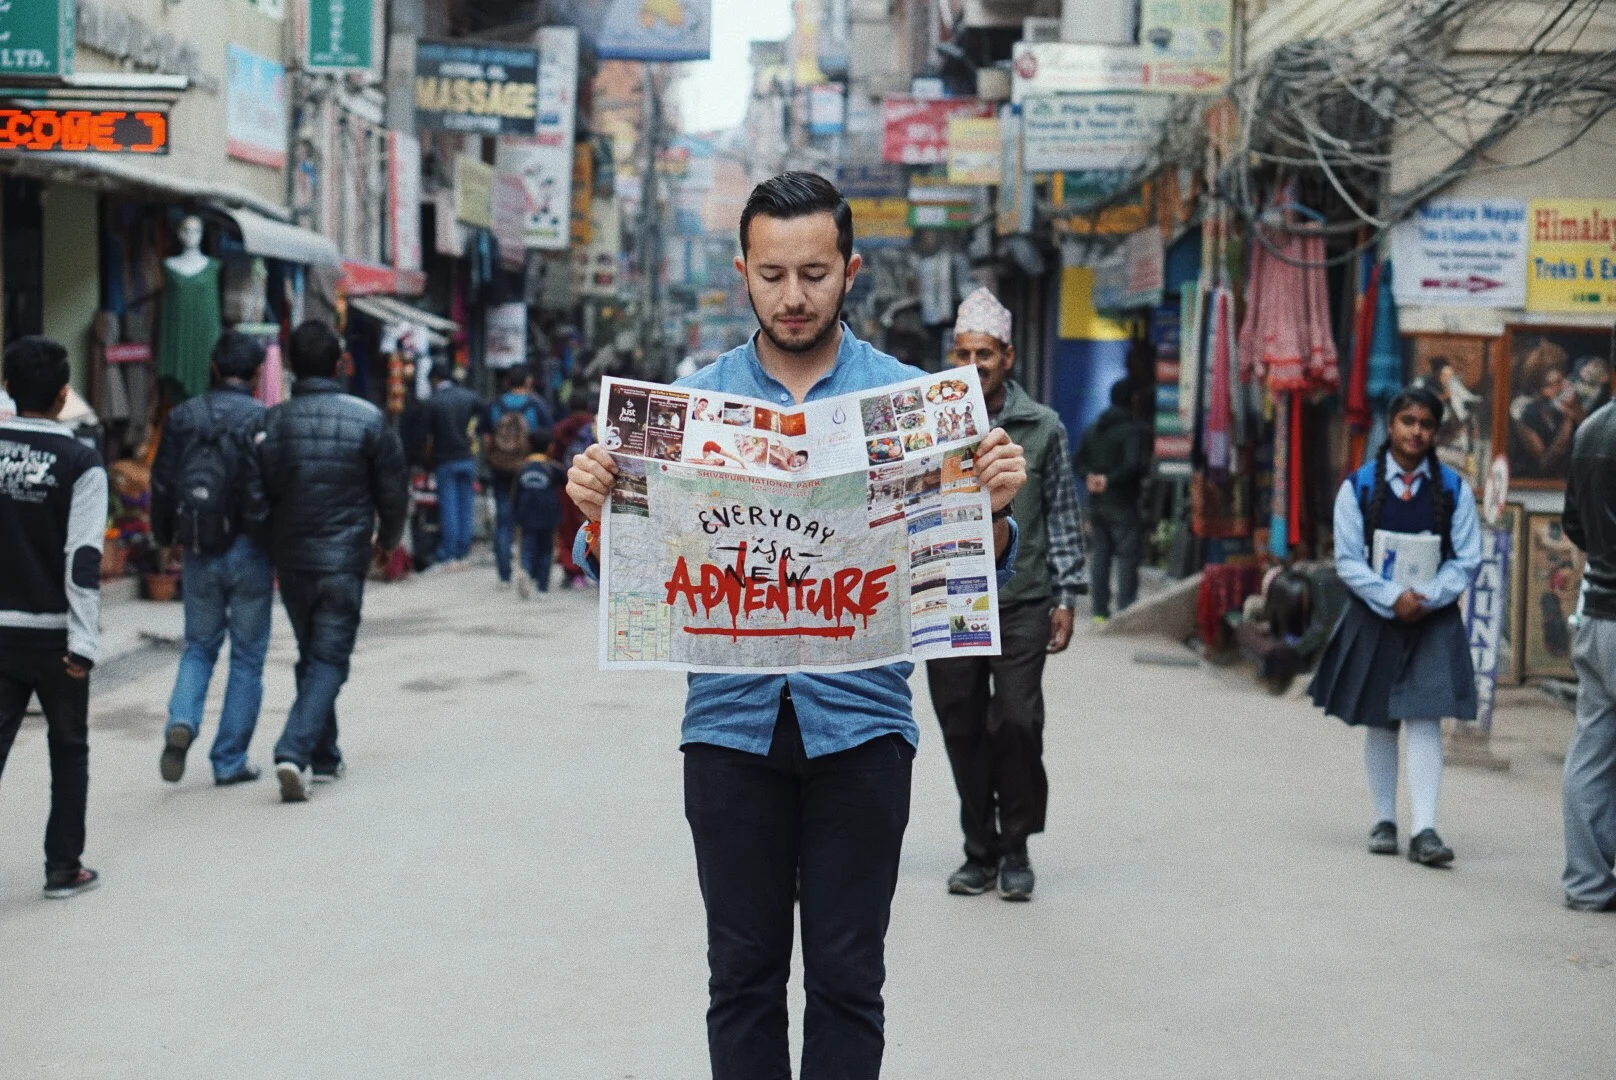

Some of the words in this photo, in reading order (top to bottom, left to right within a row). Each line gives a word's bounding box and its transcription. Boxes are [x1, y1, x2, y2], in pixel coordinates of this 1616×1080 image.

[2, 49, 50, 67] LTD.
[416, 75, 538, 119] MASSAGE
[0, 110, 126, 151] COME
[1482, 204, 1525, 223] Nepal
[1534, 256, 1577, 280] Treks
[1583, 256, 1594, 280] &
[620, 407, 636, 417] Just
[697, 470, 745, 483] SHIVAPURI
[748, 477, 793, 489] NATIONAL
[796, 480, 821, 489] PARK
[698, 505, 835, 543] EVERYDAY
[665, 541, 896, 626] ADVENTURE
[725, 560, 811, 588] NEW
